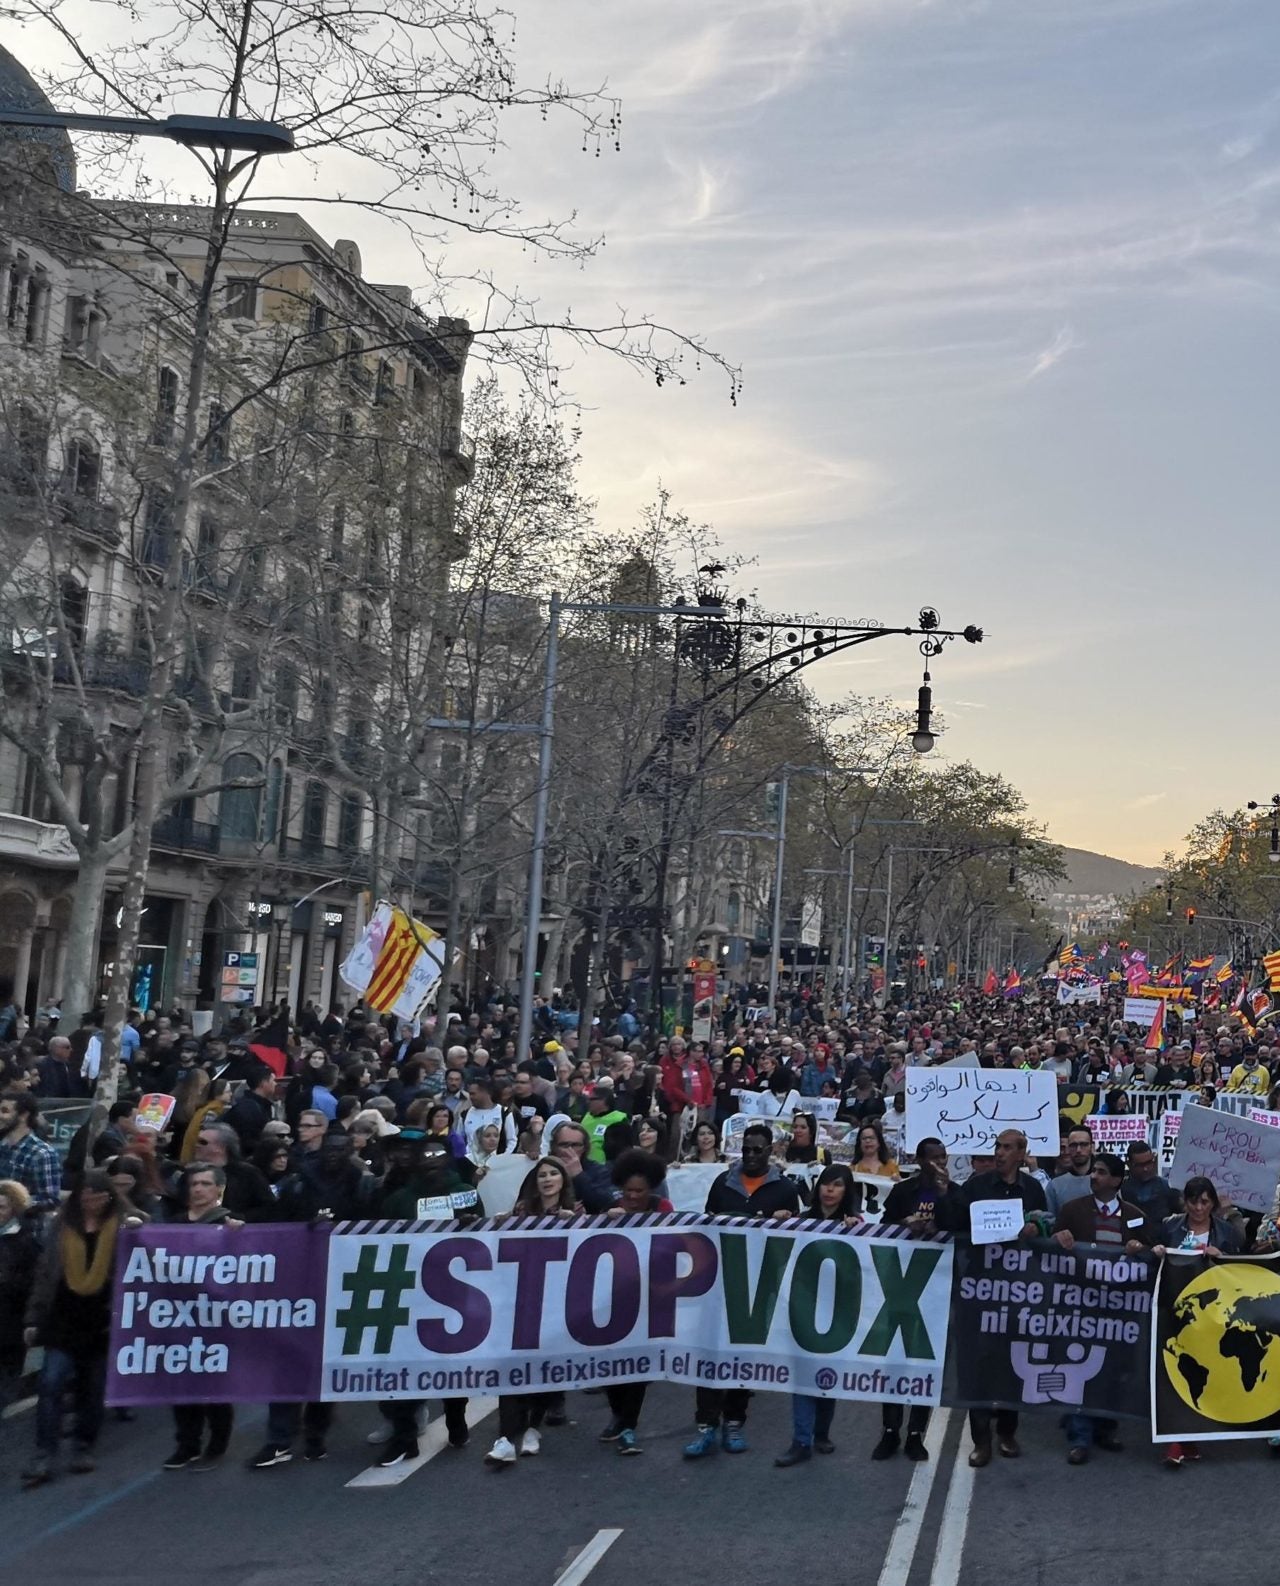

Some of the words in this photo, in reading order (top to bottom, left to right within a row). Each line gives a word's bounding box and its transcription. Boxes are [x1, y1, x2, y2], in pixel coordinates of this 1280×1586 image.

[228, 954, 239, 965] P
[1100, 1119, 1146, 1131] BUSCA
[1101, 1131, 1145, 1139] RACISME
[1213, 1122, 1261, 1150] PROU
[1186, 1162, 1241, 1187] ATACS
[919, 1202, 934, 1211] NO
[122, 1246, 276, 1284] Aturem
[983, 1245, 1033, 1276] Per
[1040, 1252, 1076, 1278] un
[1086, 1251, 1149, 1282] món
[335, 1232, 943, 1360] #STOPVOX
[960, 1278, 1044, 1304] sense
[1053, 1280, 1151, 1313] racism
[980, 1306, 1007, 1334] ni
[1018, 1306, 1140, 1345] feixisme
[117, 1337, 229, 1375] dreta
[332, 1366, 409, 1394] Unitat
[416, 1367, 501, 1391] contra
[509, 1358, 531, 1387] el
[540, 1352, 651, 1384] feixisme
[659, 1350, 666, 1376] i
[672, 1351, 691, 1377] el
[696, 1357, 790, 1385] racisme
[842, 1369, 933, 1397] ucfr.cat
